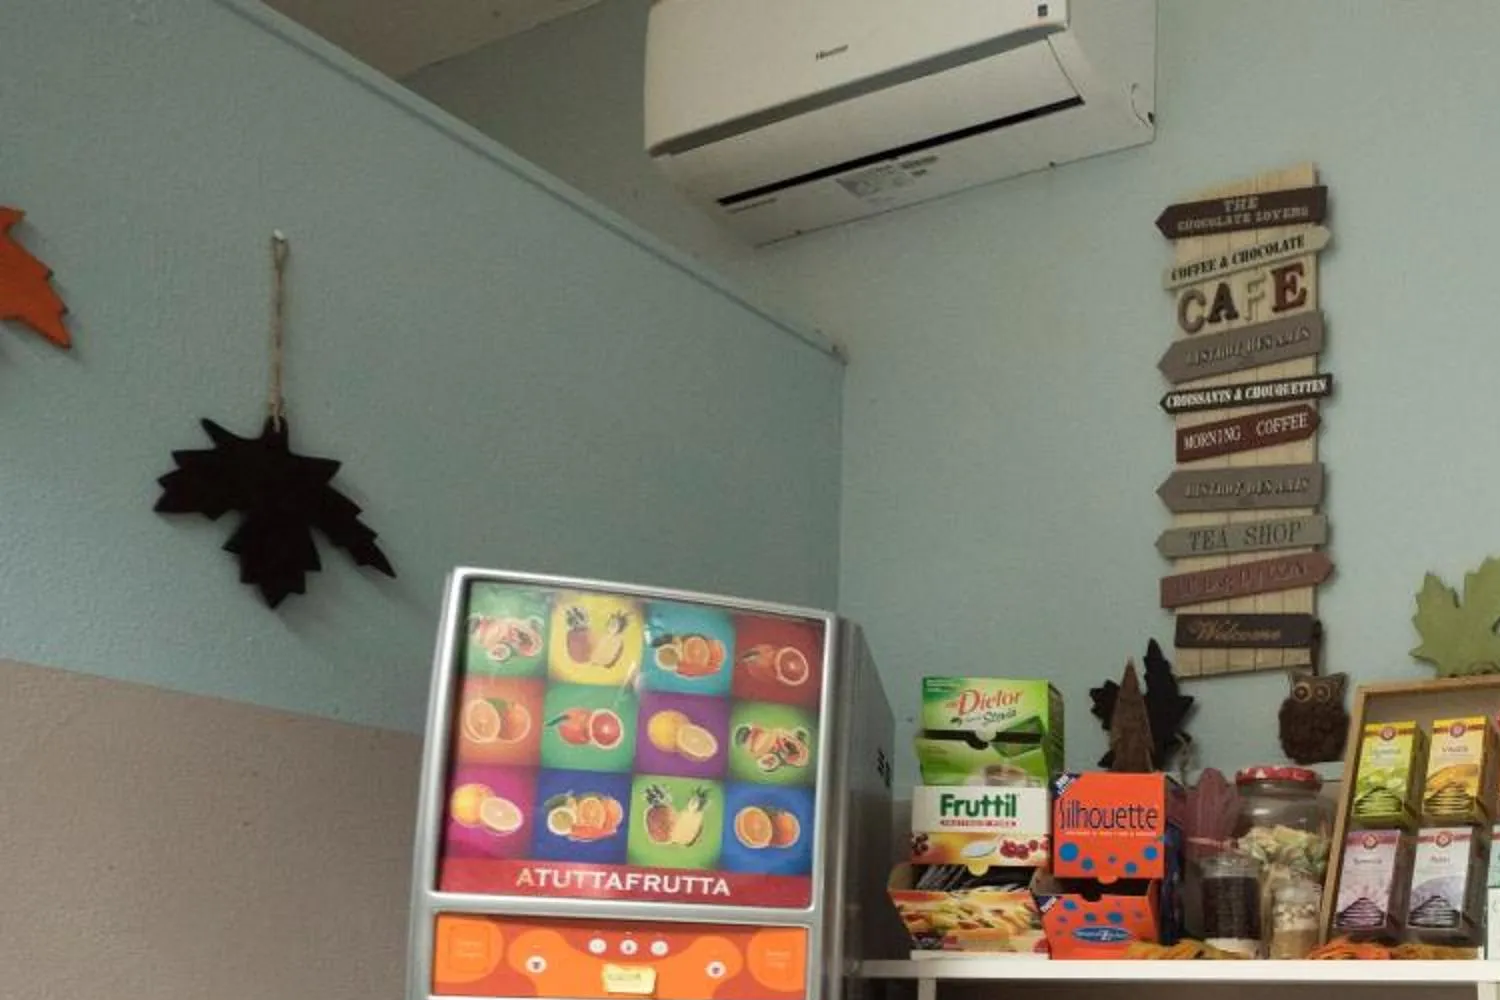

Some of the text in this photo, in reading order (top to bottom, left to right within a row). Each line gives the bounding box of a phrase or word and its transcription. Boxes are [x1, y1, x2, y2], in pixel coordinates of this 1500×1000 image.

[1223, 197, 1259, 213] THE
[1177, 211, 1253, 231] CHOCOLATE
[1171, 234, 1306, 281] COFFEE & CHOCOLATE
[1177, 261, 1308, 333] CAFE
[1183, 412, 1310, 450] MORNING COFFEE
[1189, 522, 1303, 551] TEA SHOP
[940, 793, 1017, 818] Fruttil
[1058, 797, 1158, 830] Silhouette
[516, 867, 731, 897] ATUTTAFRUTTA
